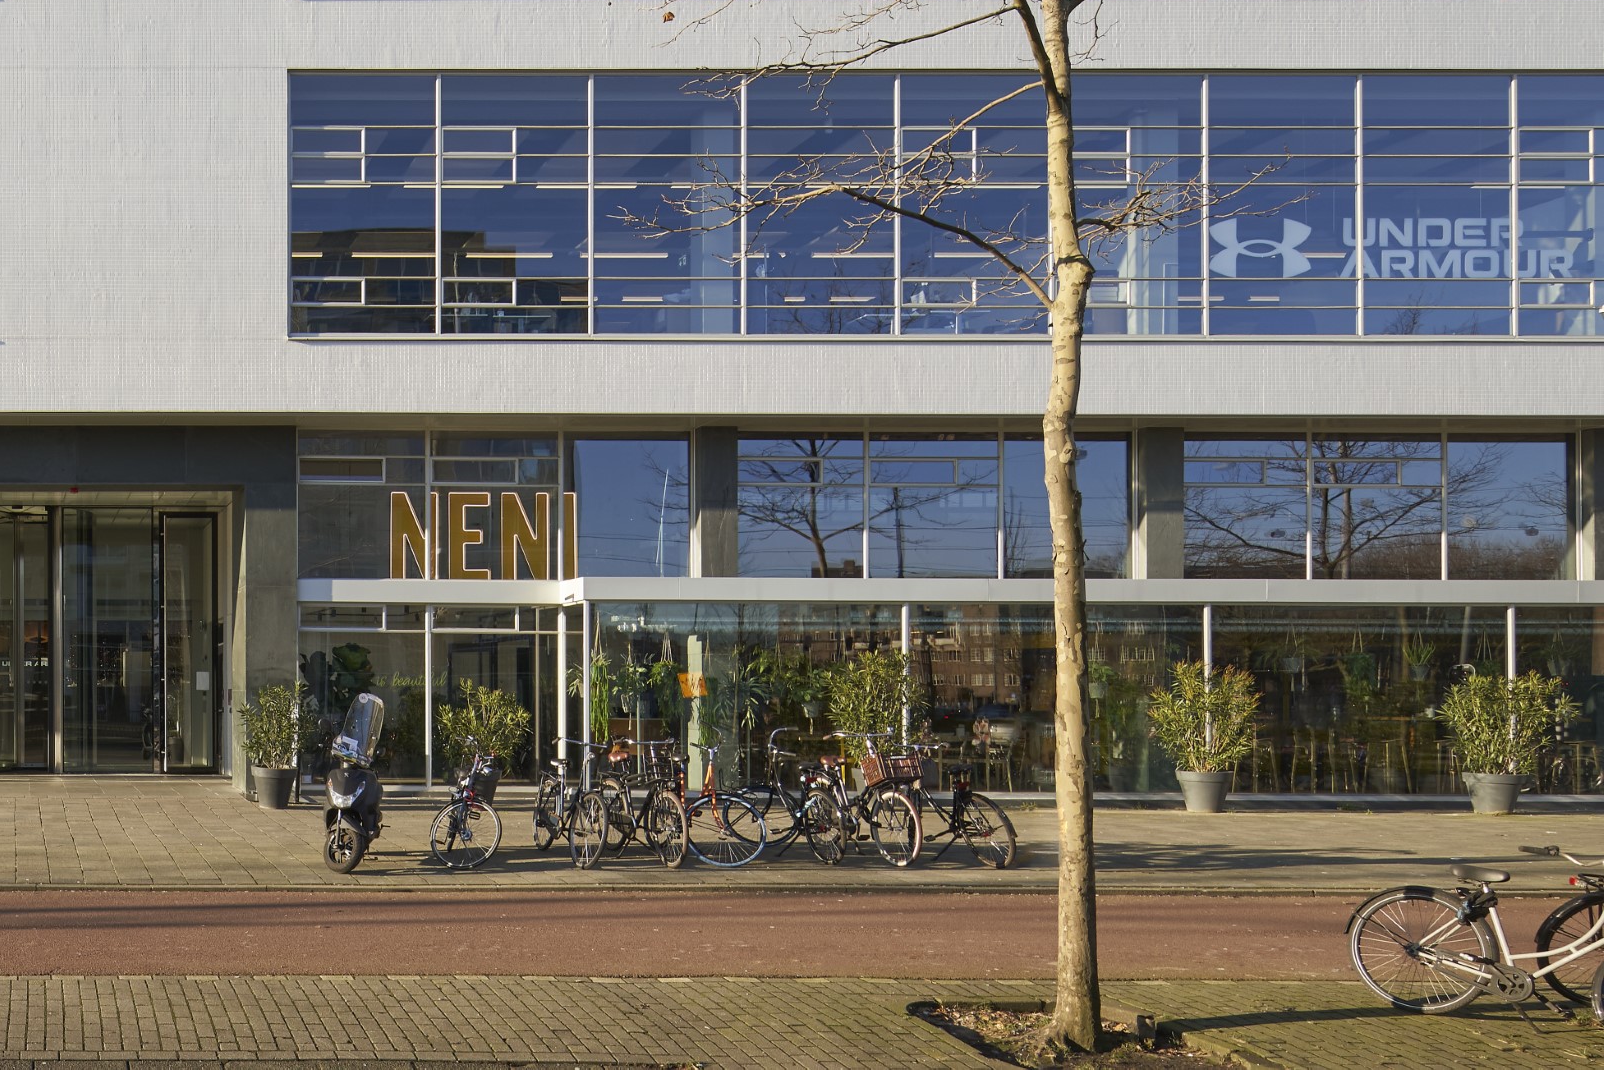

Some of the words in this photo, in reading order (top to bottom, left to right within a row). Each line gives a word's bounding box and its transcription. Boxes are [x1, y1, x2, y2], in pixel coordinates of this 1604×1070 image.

[1342, 217, 1524, 247] UNDER
[1337, 249, 1574, 279] ARMOUR
[390, 491, 578, 580] NENI
[390, 671, 448, 688] beautiul
